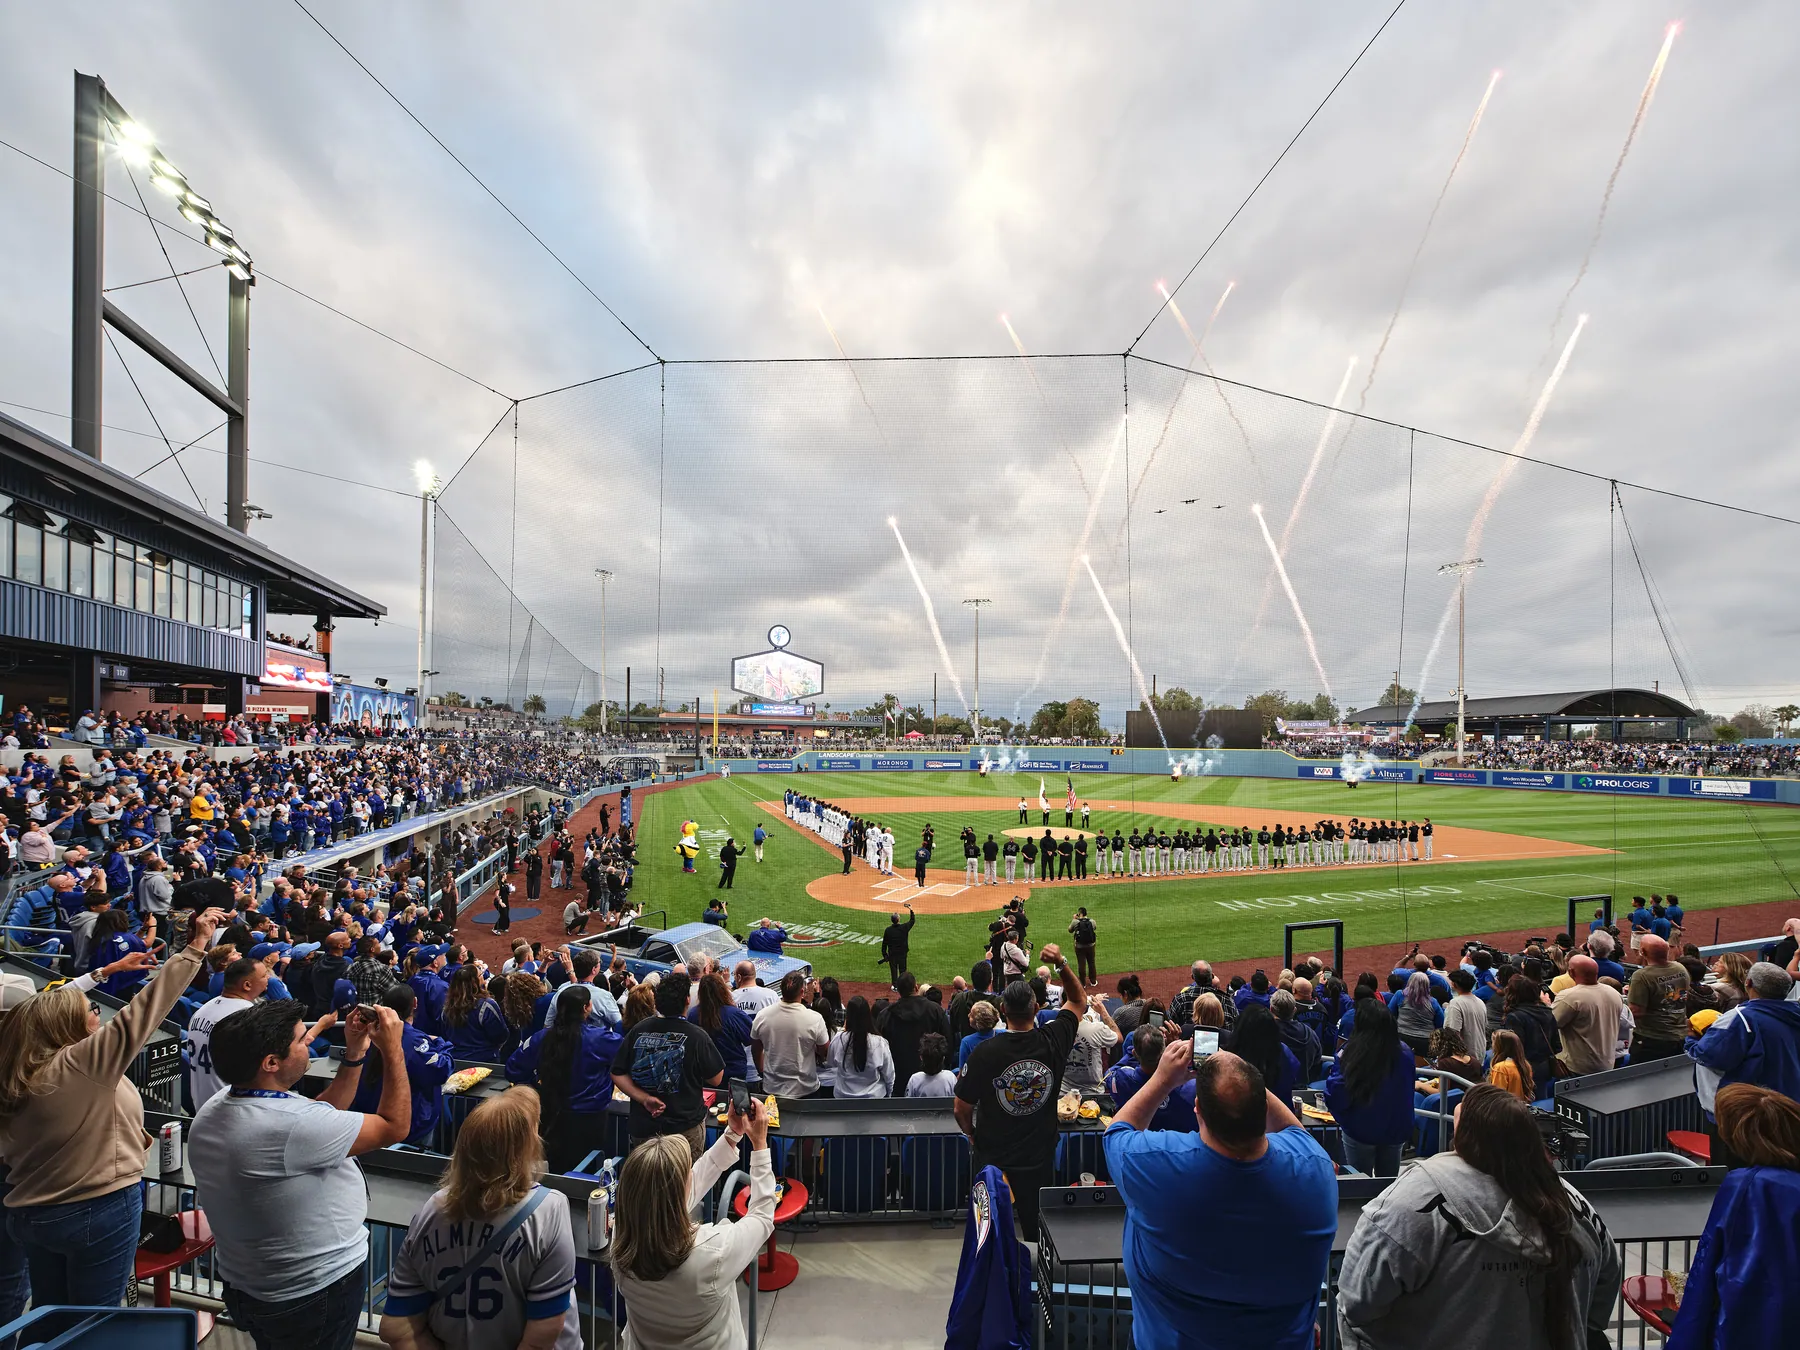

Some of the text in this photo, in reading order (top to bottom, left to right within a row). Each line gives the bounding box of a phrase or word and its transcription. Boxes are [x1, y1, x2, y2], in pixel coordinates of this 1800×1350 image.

[116, 669, 126, 677] 117
[851, 714, 883, 723] AVIONES
[1377, 770, 1404, 778] Altura
[1595, 779, 1650, 789] PROLOGIS
[1214, 885, 1463, 912] MORONGO
[835, 931, 884, 945] DAY
[737, 1001, 757, 1011] HTANI
[151, 1044, 179, 1060] 113
[187, 1038, 214, 1075] 24
[150, 1062, 180, 1074] HARD DECK
[150, 1070, 162, 1078] BOX
[1004, 1062, 1028, 1080] ONTARIO
[1557, 1103, 1584, 1125] 111
[163, 1139, 172, 1167] ULTRA
[1067, 1194, 1073, 1202] H
[1038, 1227, 1051, 1271] 112
[437, 1265, 504, 1320] 26
